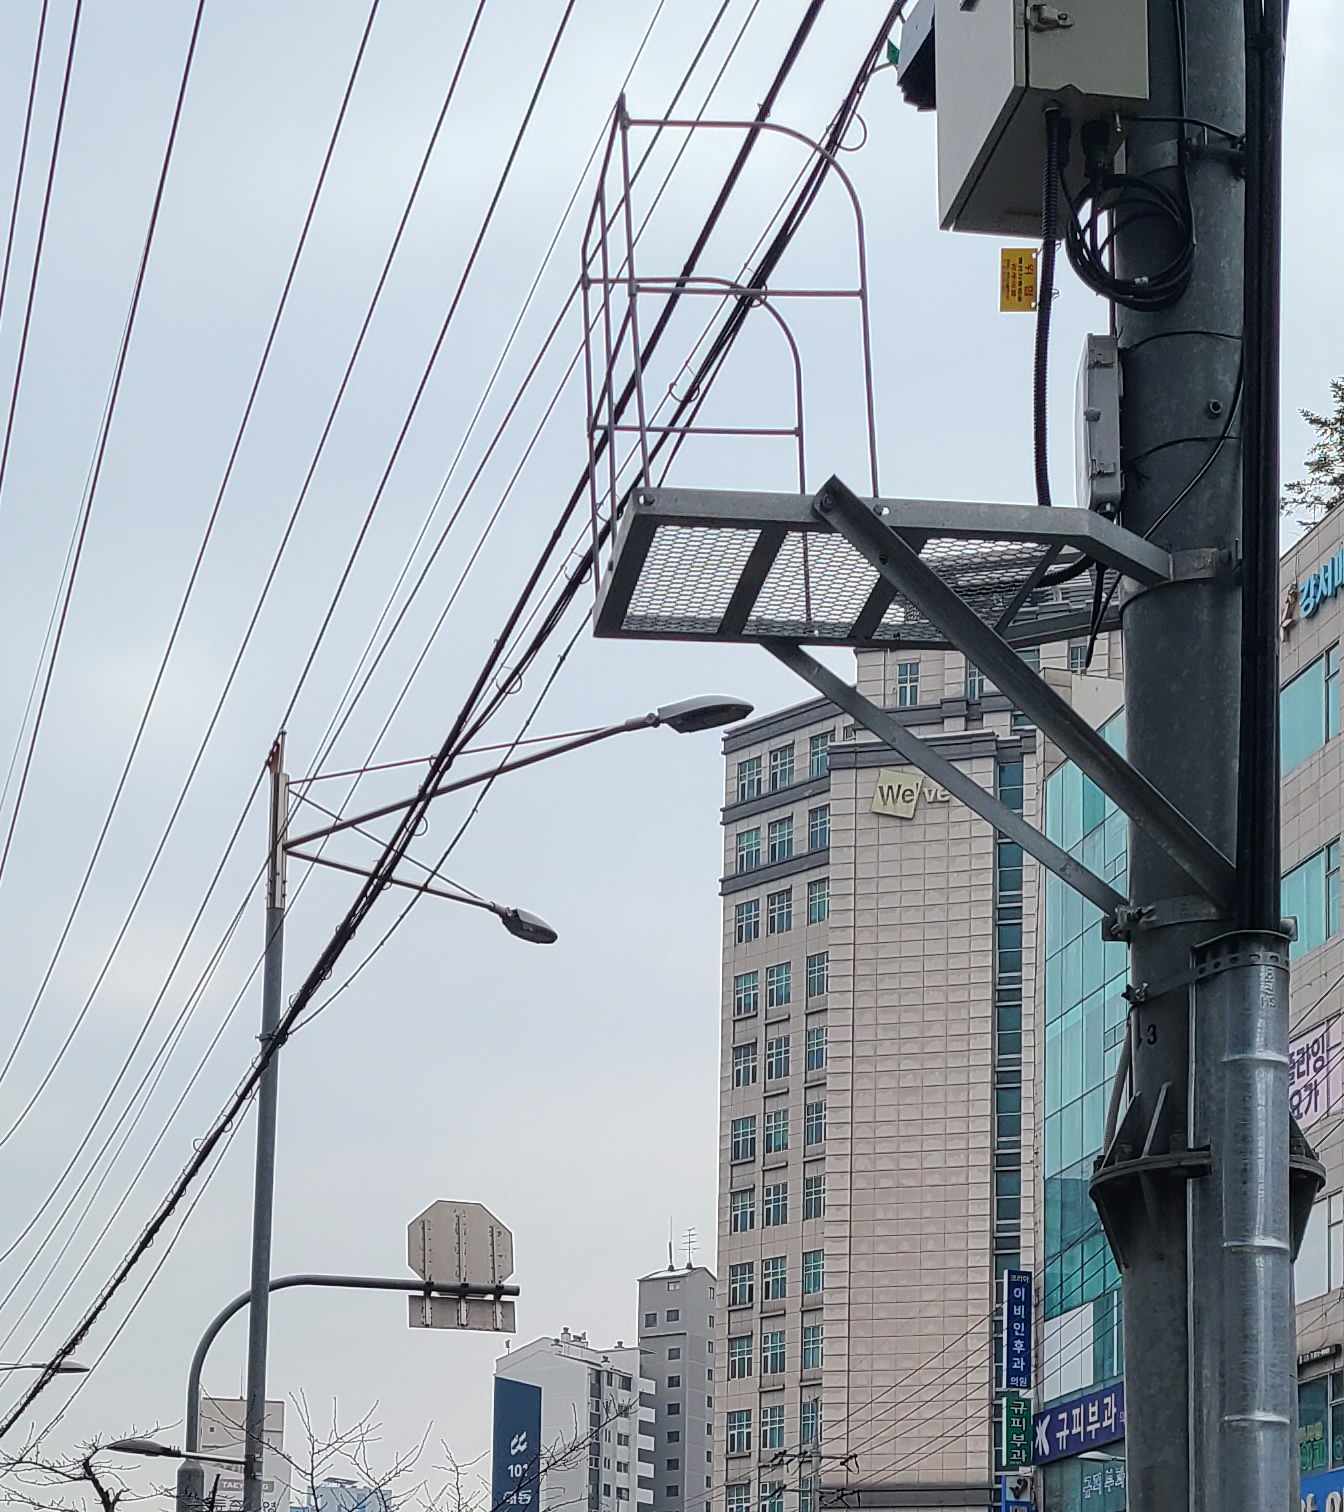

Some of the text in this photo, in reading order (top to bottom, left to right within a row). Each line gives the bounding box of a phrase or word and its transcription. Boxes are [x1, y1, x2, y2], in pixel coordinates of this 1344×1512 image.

[1290, 1079, 1319, 1120] 요가
[1012, 1287, 1025, 1372] 이비인후과
[1010, 1376, 1027, 1387] 의원
[1010, 1401, 1028, 1463] 규피부과
[1056, 1393, 1116, 1451] 규피부과
[222, 1481, 268, 1490] TAEYG
